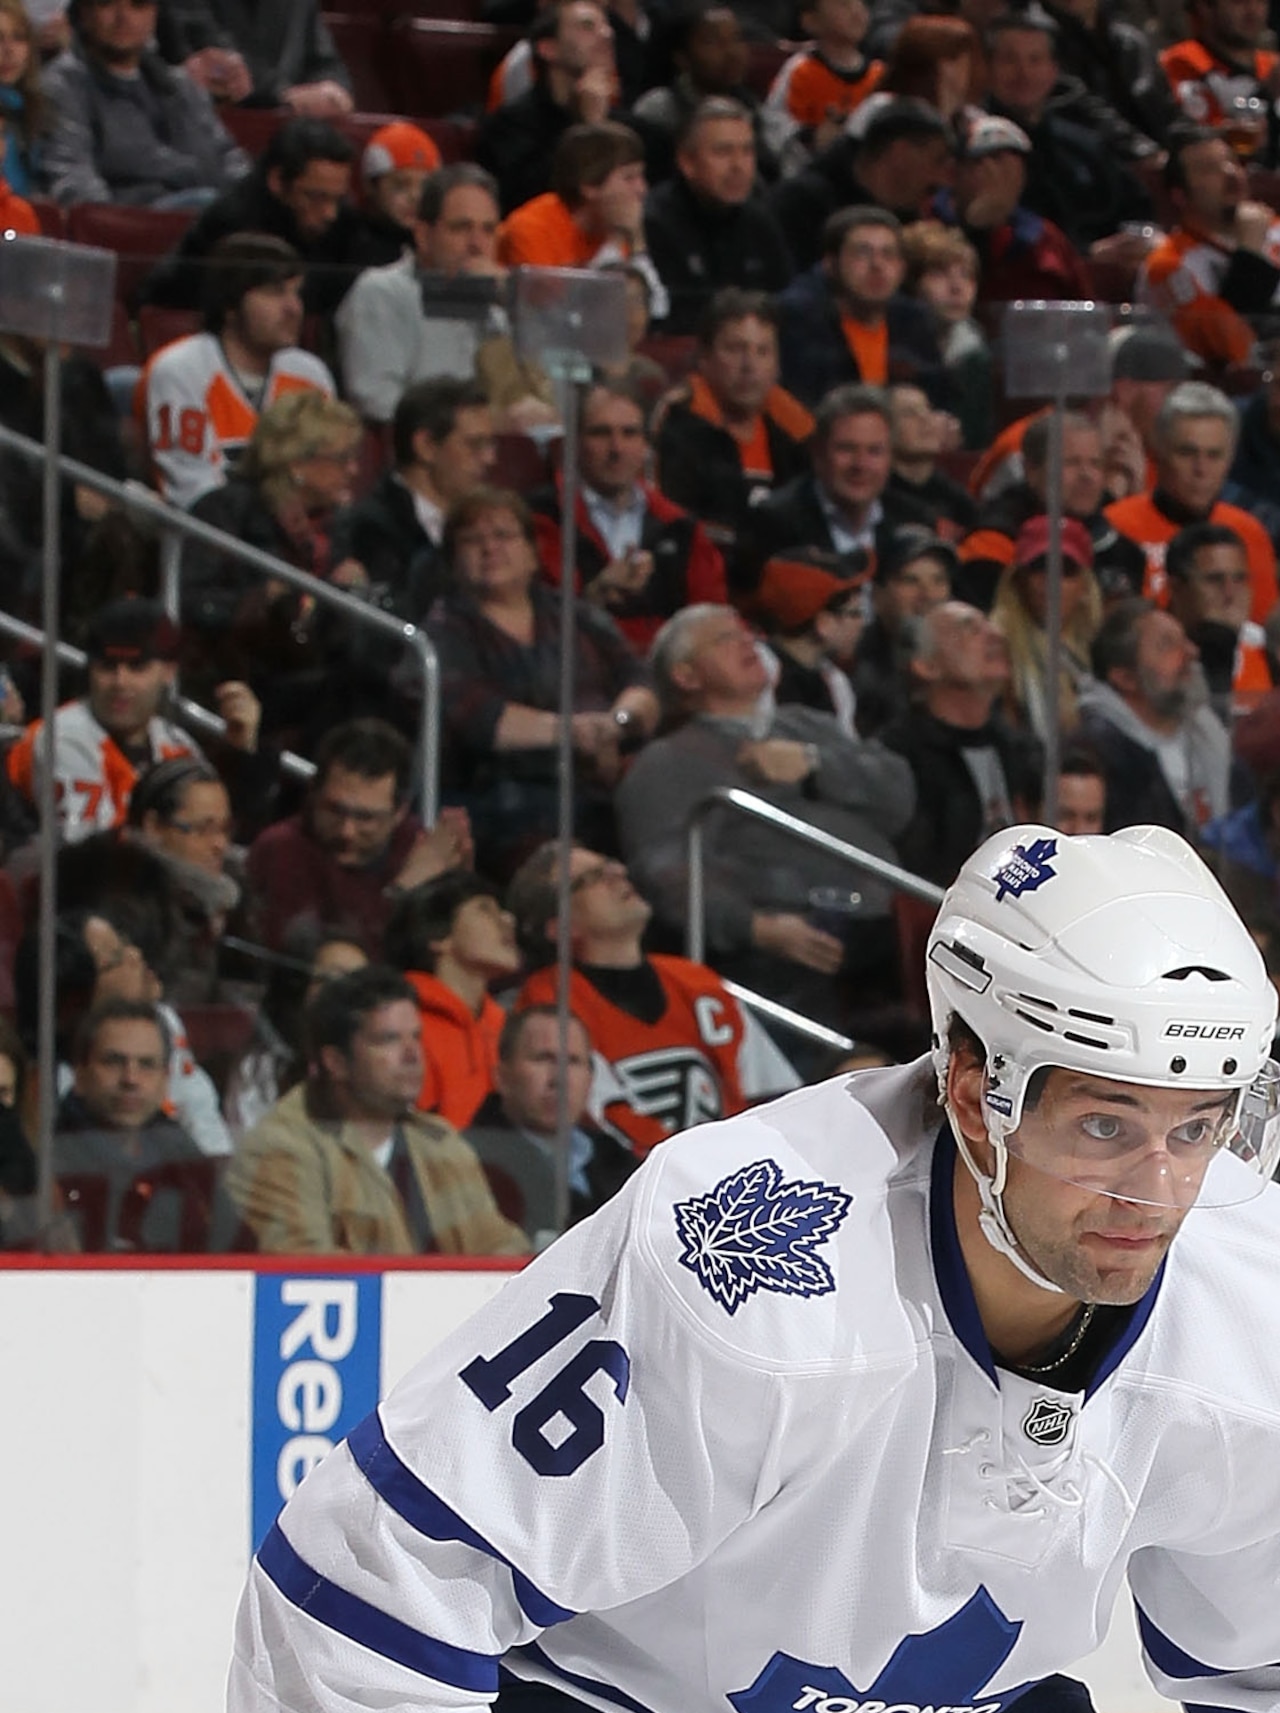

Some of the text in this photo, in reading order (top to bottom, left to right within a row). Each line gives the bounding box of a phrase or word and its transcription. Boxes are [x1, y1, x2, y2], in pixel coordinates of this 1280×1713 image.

[154, 404, 206, 455] 18
[695, 997, 733, 1045] C
[458, 1292, 630, 1477] 16
[1031, 1414, 1065, 1434] NHL
